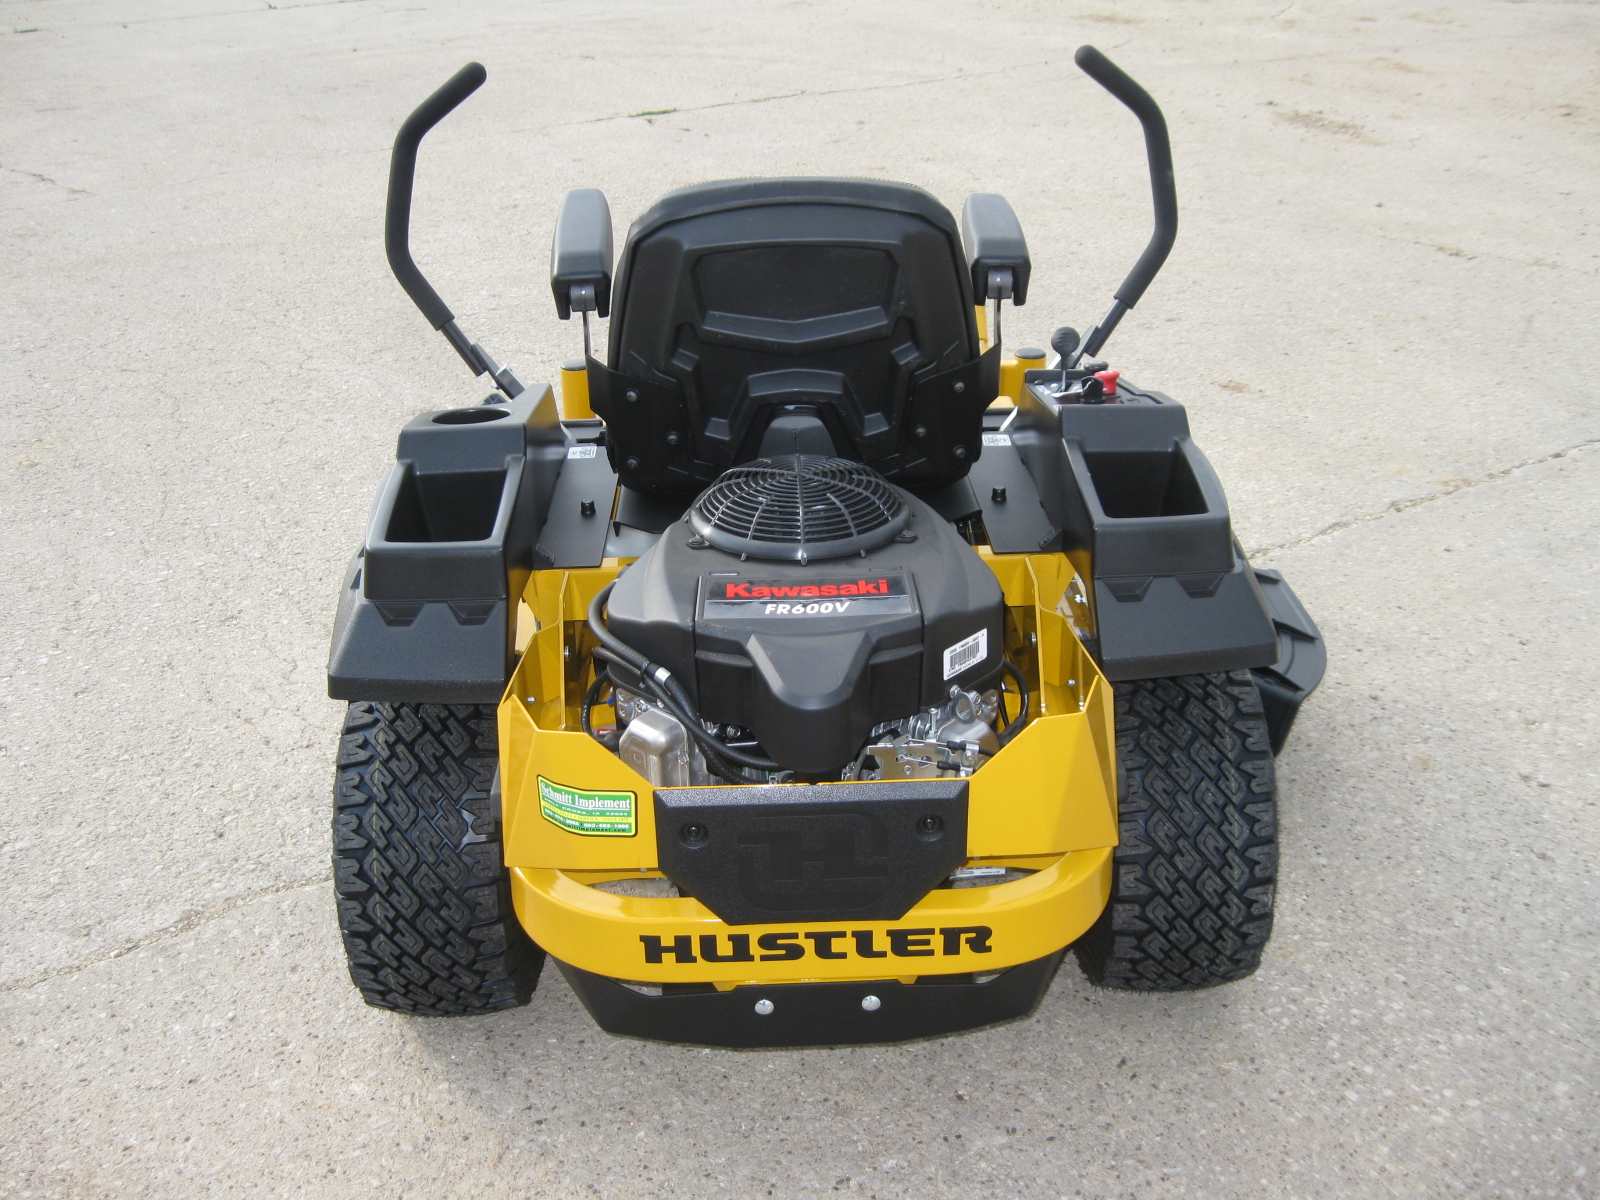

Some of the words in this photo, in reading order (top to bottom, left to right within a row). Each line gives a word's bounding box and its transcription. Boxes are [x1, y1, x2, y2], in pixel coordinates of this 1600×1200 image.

[725, 579, 889, 598] Kawasaki
[764, 601, 851, 615] FR600V
[541, 782, 573, 805] Schmitt
[575, 795, 630, 810] Implement
[639, 925, 993, 963] HUSTLER
